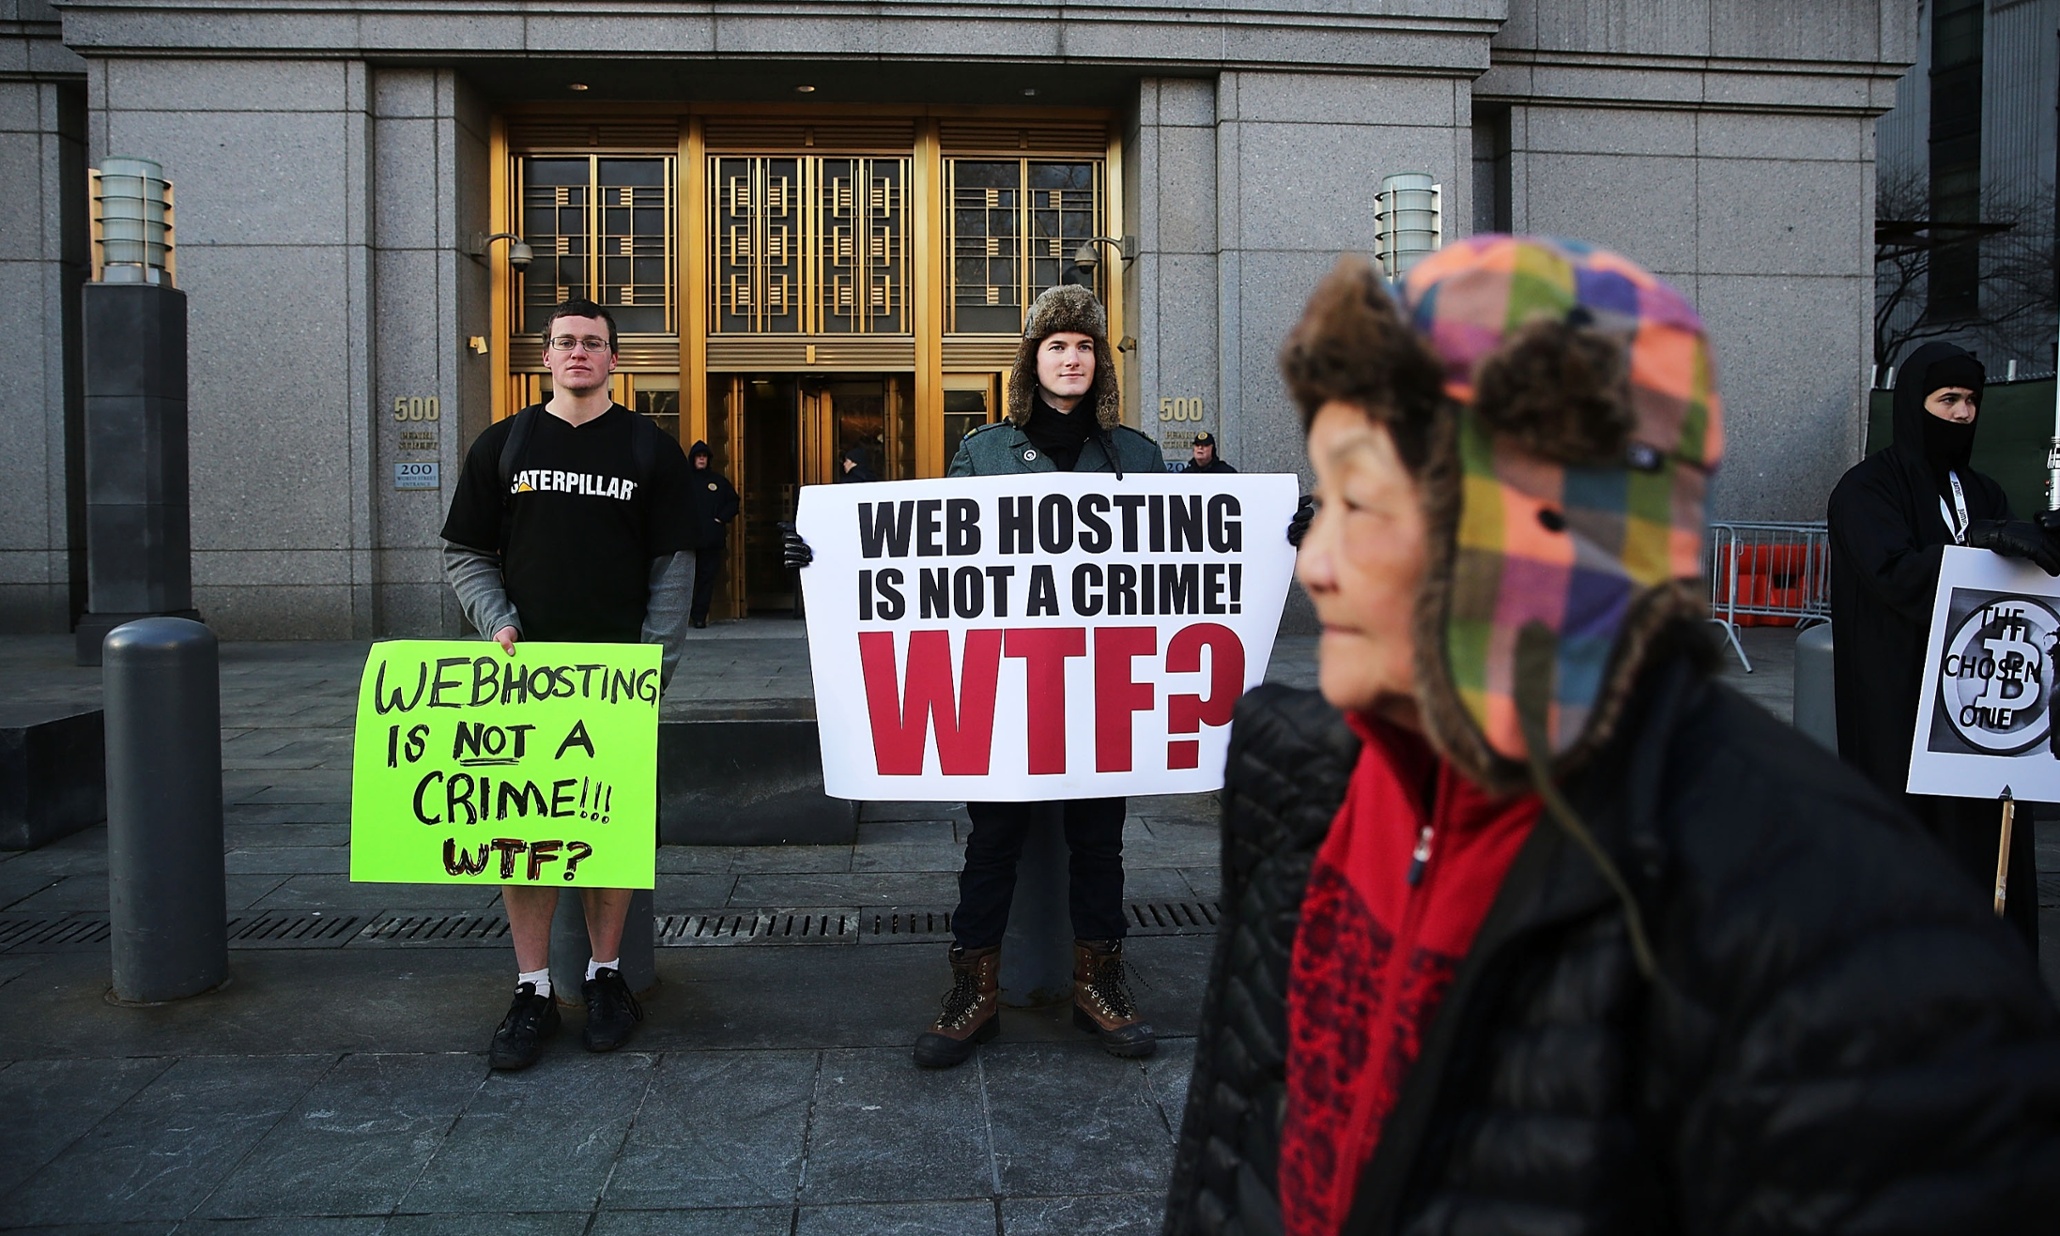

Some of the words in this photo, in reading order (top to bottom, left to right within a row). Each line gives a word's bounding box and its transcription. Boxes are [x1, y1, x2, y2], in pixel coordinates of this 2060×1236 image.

[394, 396, 440, 421] 500
[1159, 397, 1203, 421] 500
[401, 464, 432, 475] 200
[1167, 462, 1185, 472] 20
[858, 498, 982, 559] WEB
[998, 493, 1242, 554] HOSTING
[858, 567, 906, 621] IS
[919, 565, 1015, 620] NOT
[1026, 564, 1060, 617] A
[1072, 562, 1242, 617] CRIME!
[1980, 606, 2025, 632] THE
[375, 656, 658, 716] WEBHOSTING
[1944, 654, 2042, 684] CHOSEN
[858, 622, 1246, 776] WTF?
[1959, 704, 2013, 730] ONE
[387, 724, 430, 768] IS
[453, 720, 536, 760] NOT
[554, 719, 595, 760] A
[412, 770, 612, 826] CRIME!!!
[442, 837, 593, 882] WTF?
